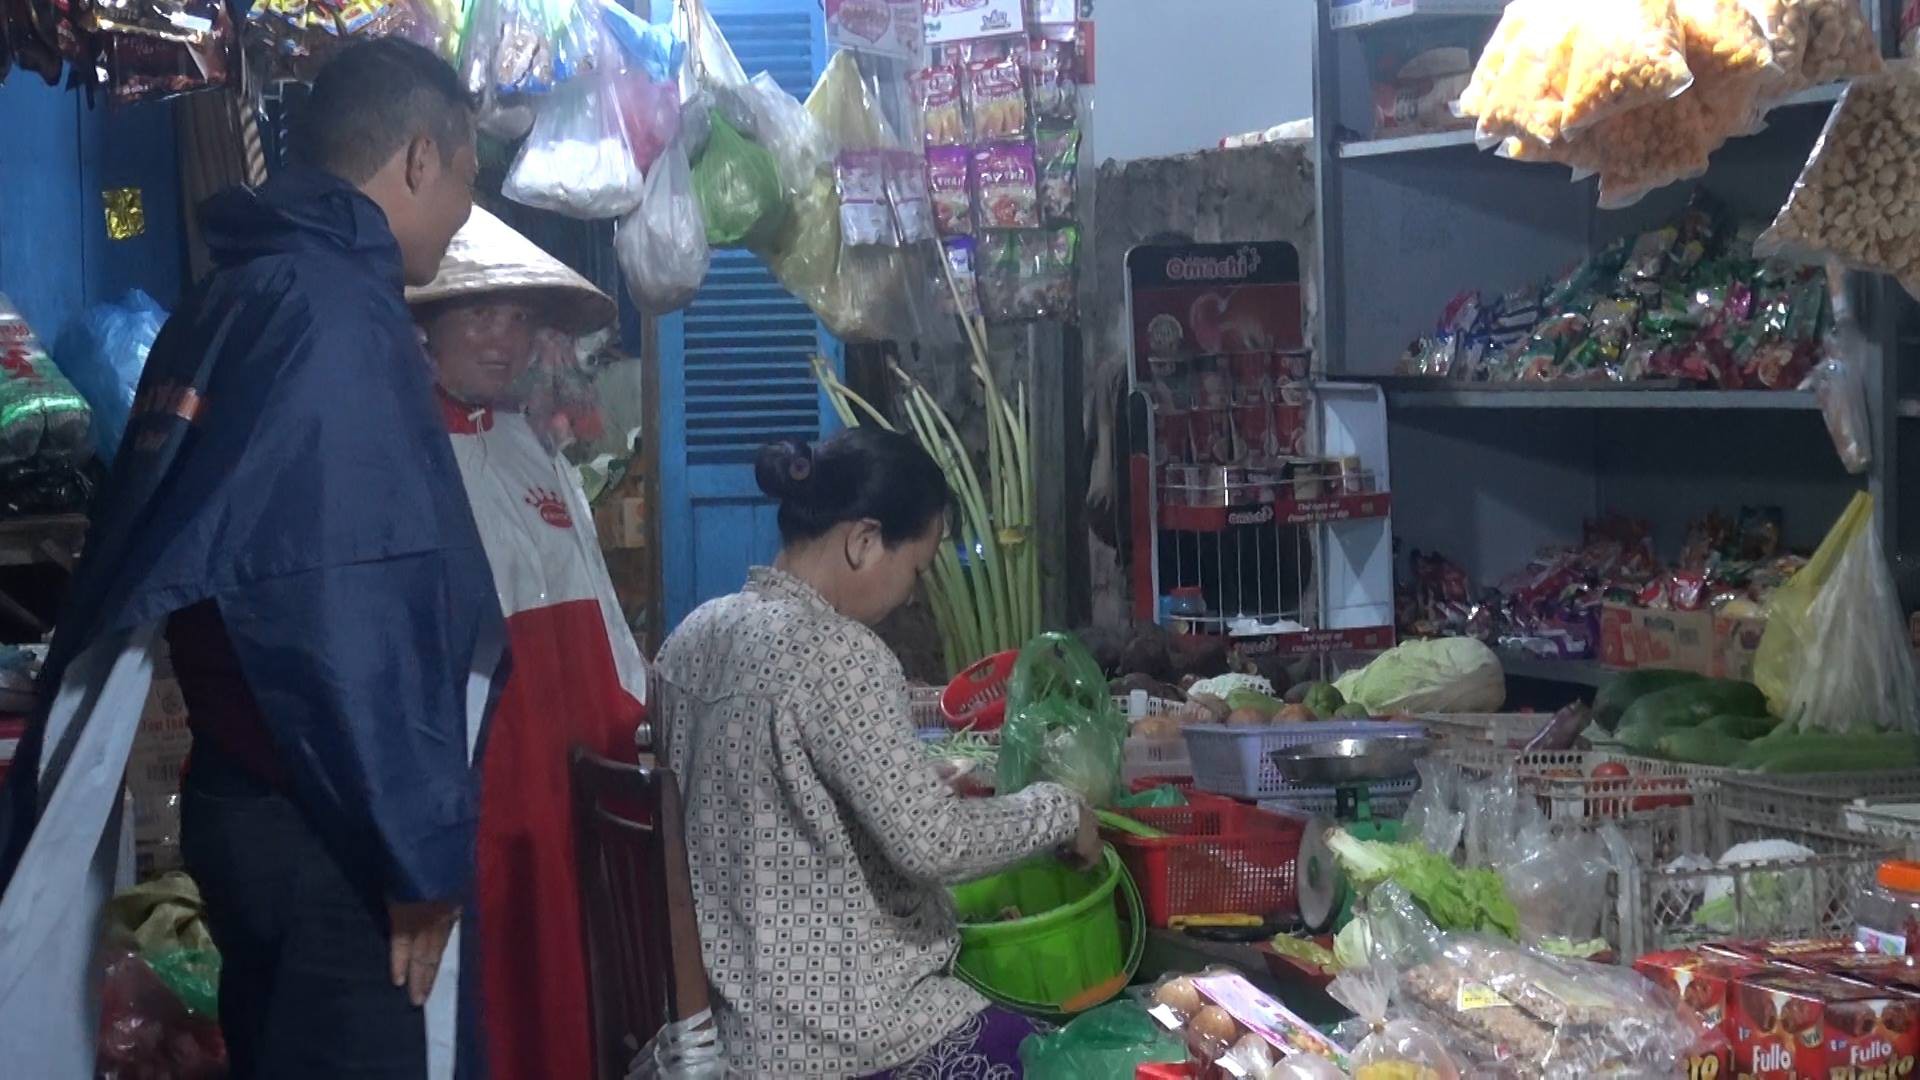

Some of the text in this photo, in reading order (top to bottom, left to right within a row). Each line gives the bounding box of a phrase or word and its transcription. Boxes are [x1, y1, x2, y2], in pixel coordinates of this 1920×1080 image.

[1166, 250, 1250, 280] Omachi
[1753, 1044, 1791, 1073] Fullo
[1850, 1040, 1892, 1065] Fullo
